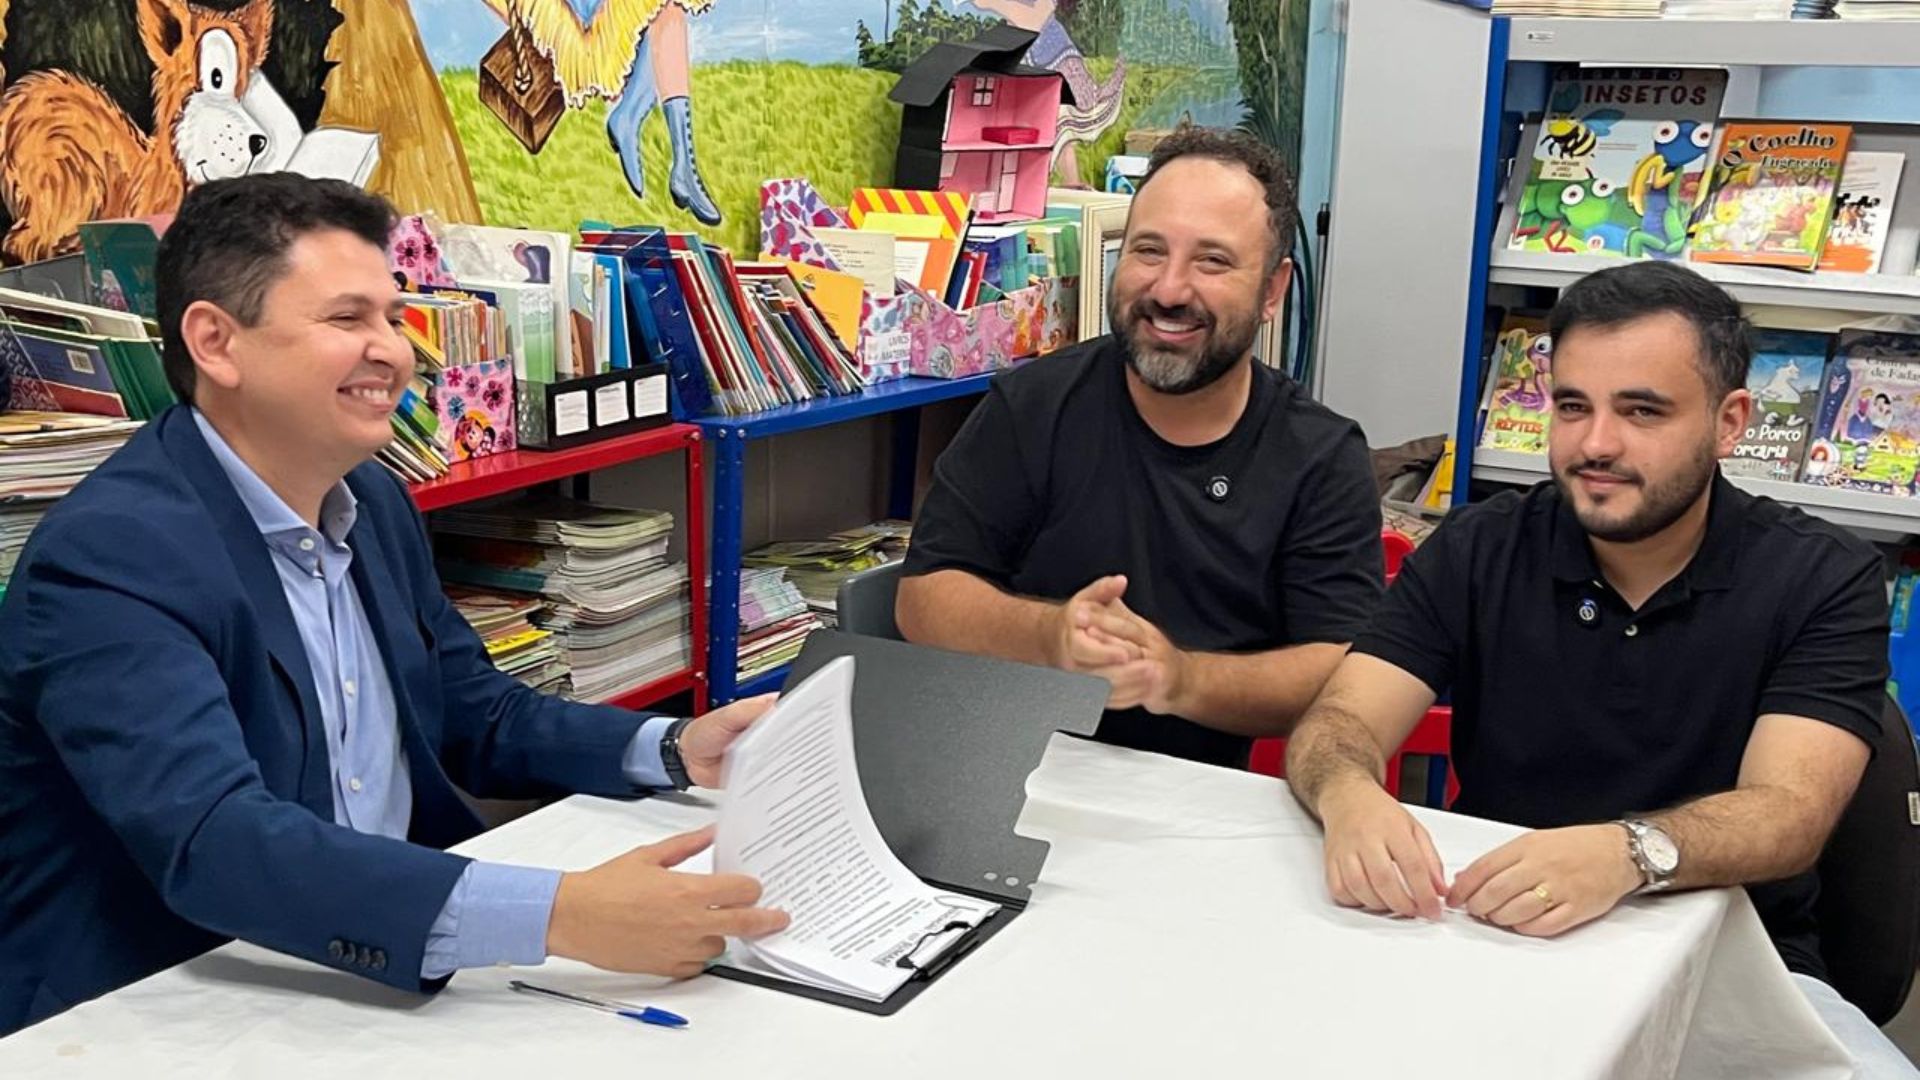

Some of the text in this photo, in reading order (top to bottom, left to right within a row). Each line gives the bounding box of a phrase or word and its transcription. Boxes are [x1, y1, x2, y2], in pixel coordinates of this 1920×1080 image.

[1584, 85, 1707, 105] INSETOS
[1749, 127, 1836, 152] Coelho
[1758, 424, 1803, 441] Porco
[1733, 444, 1789, 460] orcaria
